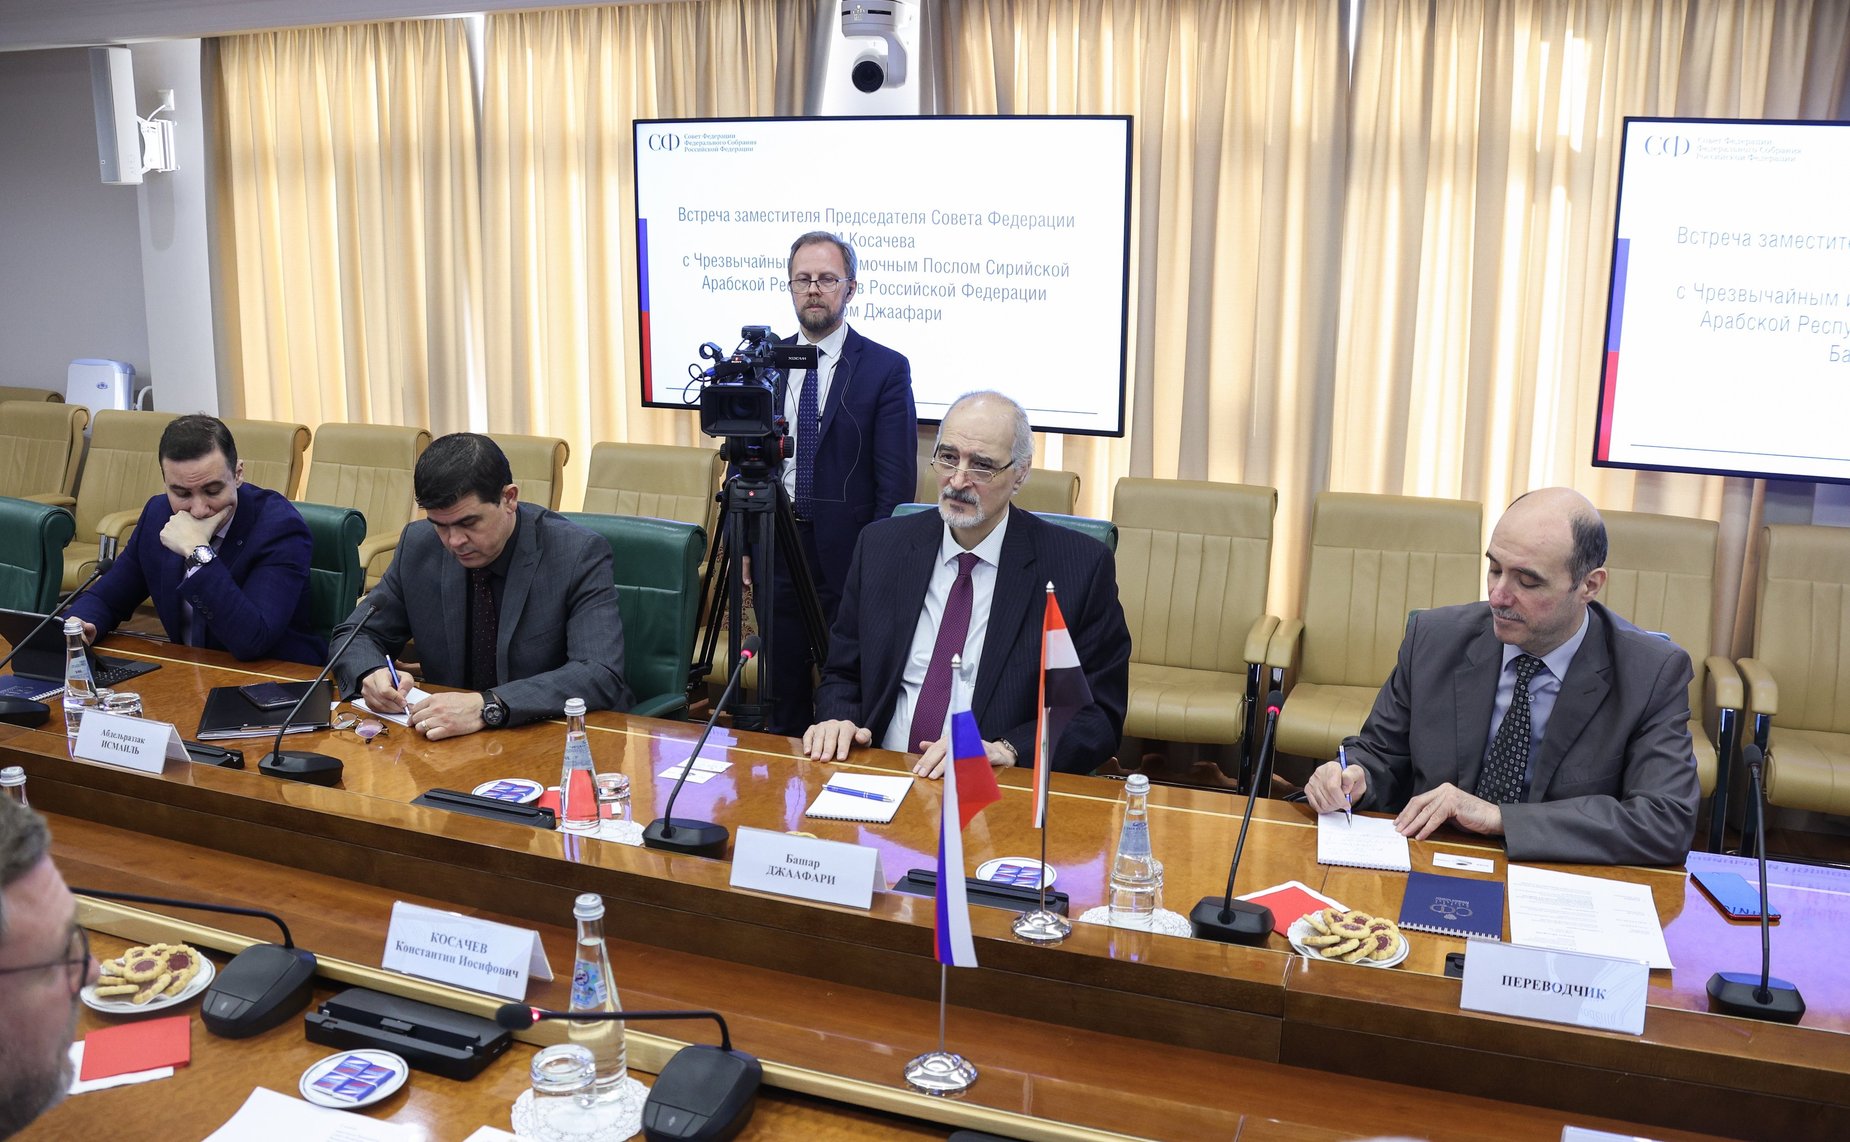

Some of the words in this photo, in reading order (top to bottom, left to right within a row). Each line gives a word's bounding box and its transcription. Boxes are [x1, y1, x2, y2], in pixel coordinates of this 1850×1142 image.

[648, 133, 680, 151] СФ
[678, 206, 730, 224] Встреча
[734, 209, 821, 223] заместителя
[825, 208, 926, 225] Председателя
[931, 209, 983, 226] Совета
[988, 210, 1076, 230] Федерации
[1677, 226, 1752, 250] Встреча
[682, 255, 690, 267] с
[923, 257, 981, 275] Послом
[986, 259, 1070, 278] Сирийской
[702, 275, 765, 293] Арабской
[857, 283, 865, 294] в
[869, 279, 956, 298] Российской
[961, 283, 1047, 302] Федерации
[1676, 285, 1686, 300] с
[1694, 282, 1839, 307] Чрезвычайным
[864, 303, 943, 322] Джаафари
[1699, 310, 1790, 333] Арабской
[101, 740, 140, 755] ИСМАИЛЬ
[786, 853, 821, 870] Башар
[766, 865, 836, 885] ДЖААФАРИ
[430, 931, 488, 954] КОСАЧЕВ
[395, 940, 456, 964] Константин
[458, 955, 519, 979] Иосифович
[1501, 974, 1607, 1000] ПЕРЕВОДЧИК
